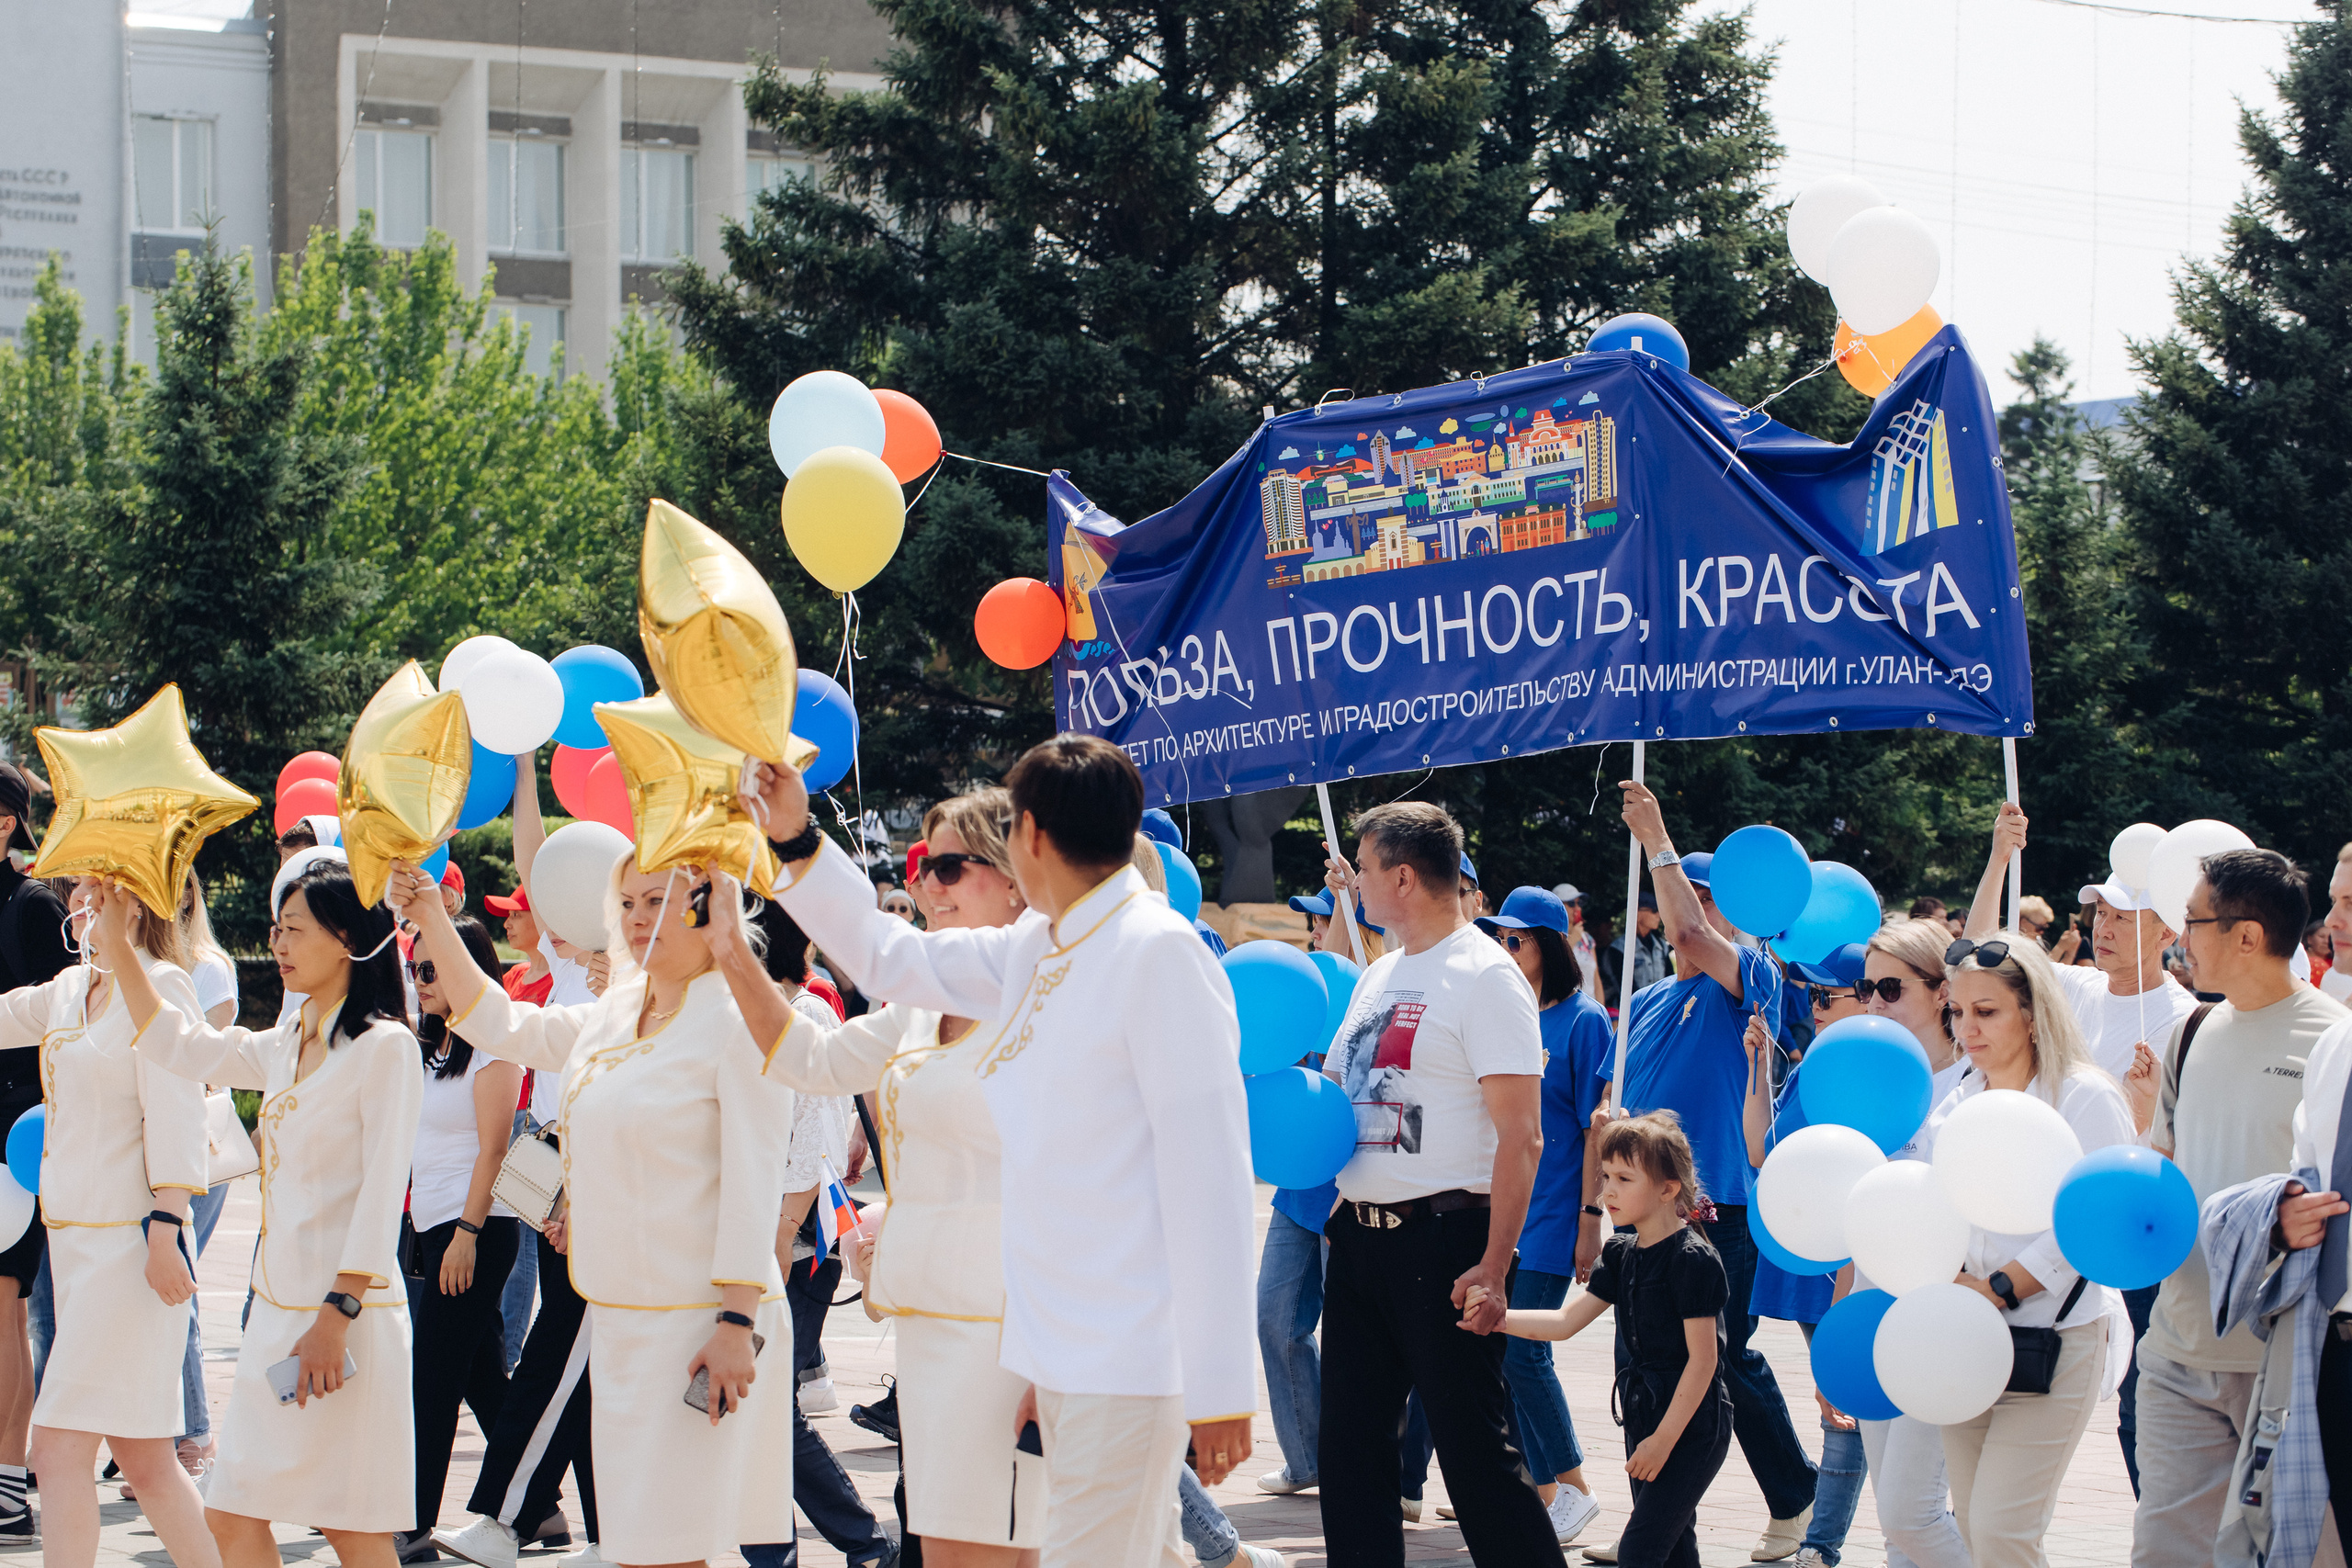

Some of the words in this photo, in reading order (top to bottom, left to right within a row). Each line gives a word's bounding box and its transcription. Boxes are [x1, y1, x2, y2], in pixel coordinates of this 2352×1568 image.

[1266, 567, 1650, 685] ПРОЧНОСТЬ,
[1154, 735, 1178, 764] ПО
[1183, 713, 1314, 759] АРХИТЕКТУРЕ
[1600, 657, 1836, 698] АДМИНИСТРАЦИИ
[1340, 990, 1380, 1091] USUAL
[1395, 1020, 1417, 1029] PERFECT
